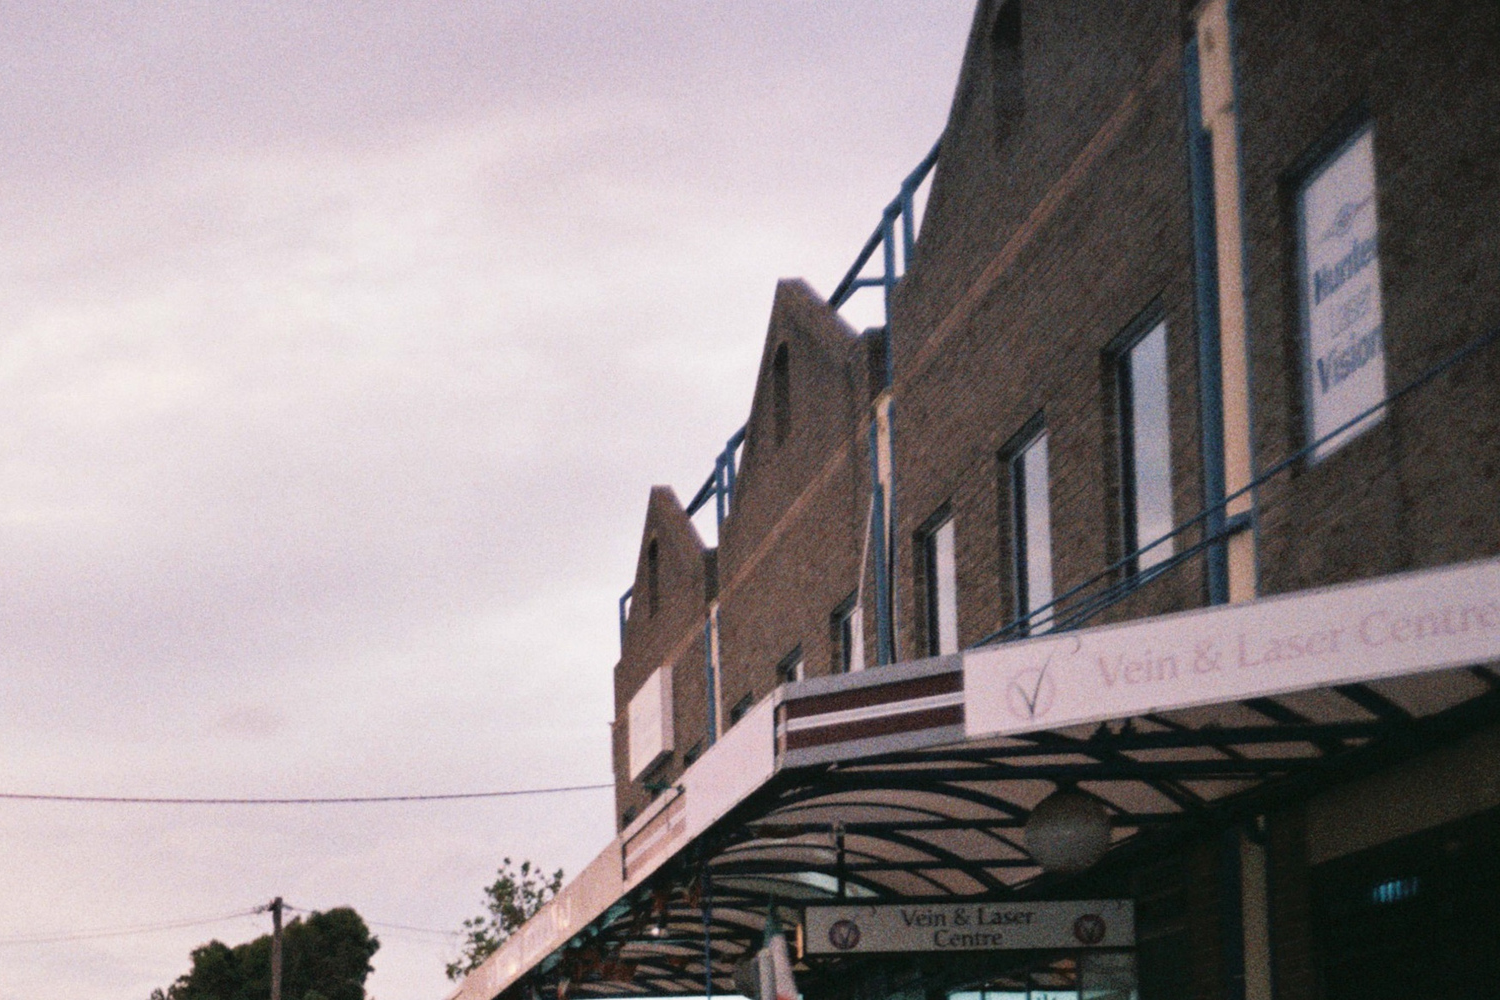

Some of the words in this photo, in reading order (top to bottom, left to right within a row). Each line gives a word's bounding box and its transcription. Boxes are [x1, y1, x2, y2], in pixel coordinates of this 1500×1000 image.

[1098, 650, 1180, 688] Vein
[1193, 637, 1224, 673] &
[1238, 627, 1343, 670] Laser
[1359, 601, 1500, 650] Centre
[900, 907, 952, 928] Vein
[954, 907, 967, 926] &
[977, 906, 1035, 927] Laser
[933, 929, 1004, 949] Centre
